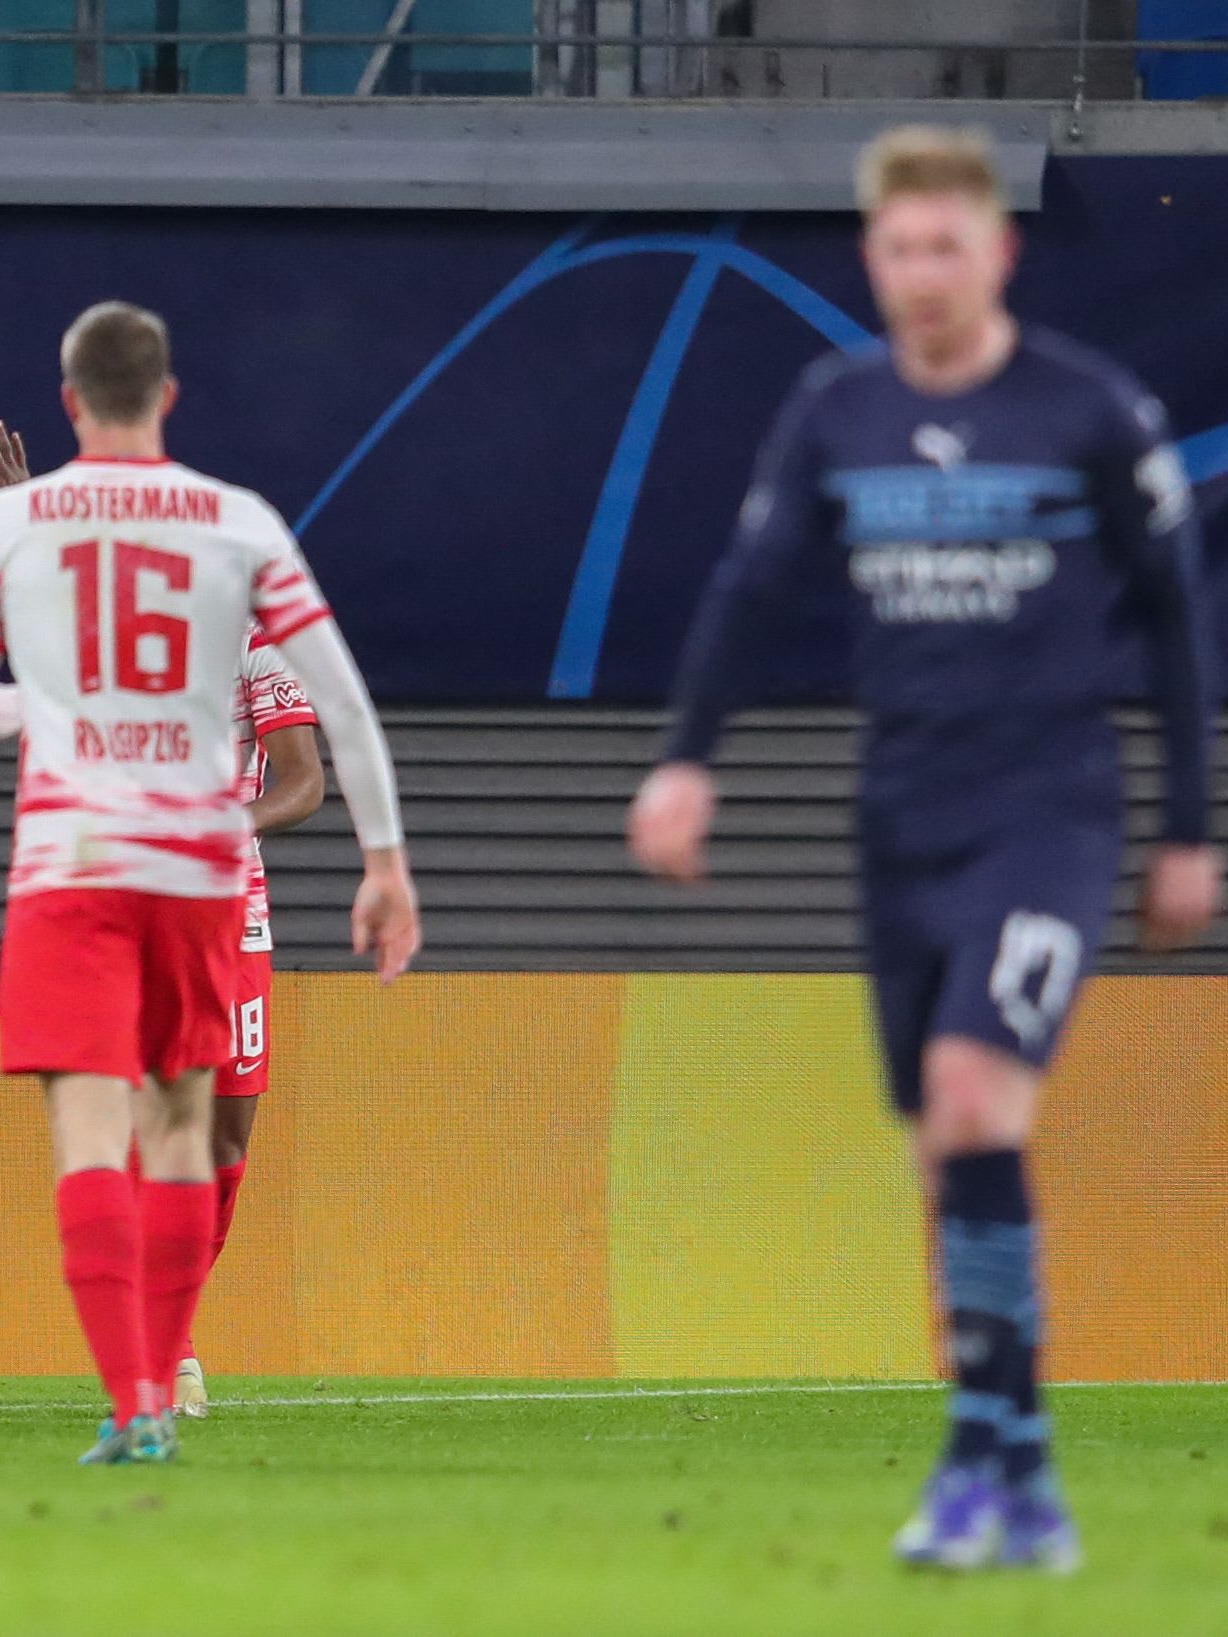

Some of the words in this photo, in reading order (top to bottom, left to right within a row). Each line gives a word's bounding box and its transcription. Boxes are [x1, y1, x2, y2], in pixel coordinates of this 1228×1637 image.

[29, 485, 221, 525] KLOSTERMANN
[60, 539, 191, 697] 16
[73, 718, 106, 762] RB
[111, 720, 191, 764] LEIPZIG
[229, 995, 264, 1058] 18
